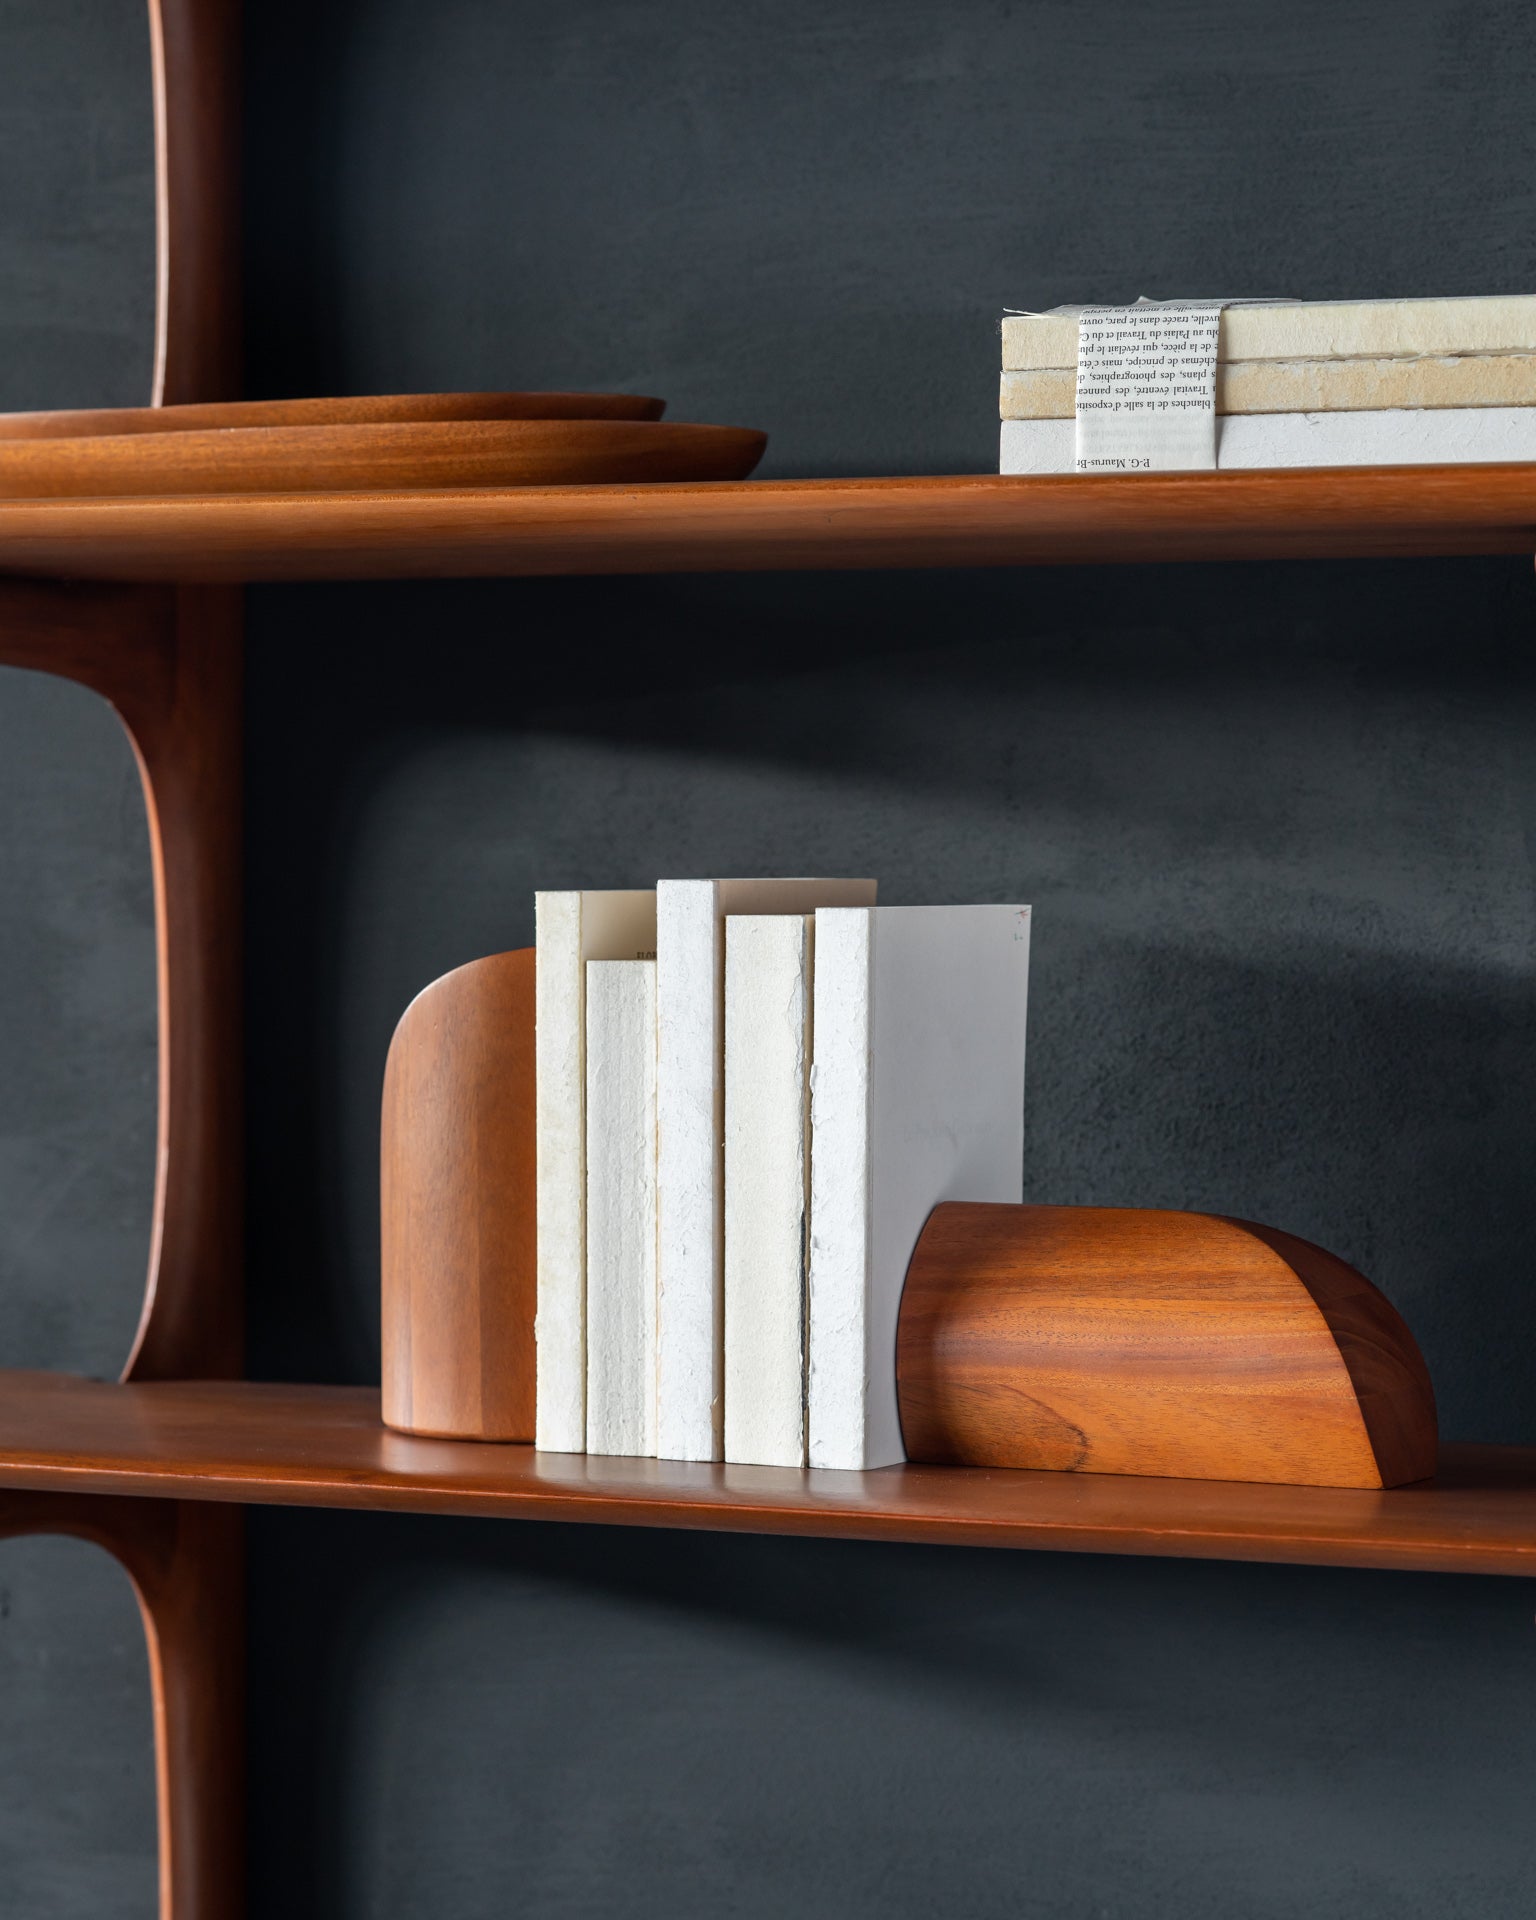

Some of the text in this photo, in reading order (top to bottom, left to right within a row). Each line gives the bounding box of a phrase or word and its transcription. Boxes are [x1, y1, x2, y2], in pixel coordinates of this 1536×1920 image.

[1105, 315, 1128, 324] parc,
[1129, 318, 1137, 327] le
[1139, 317, 1160, 326] dans
[1162, 316, 1189, 325] tracée
[1092, 332, 1104, 341] du
[1116, 331, 1147, 341] Travail
[1149, 331, 1162, 340] du
[1163, 330, 1190, 339] Palais
[1080, 343, 1095, 355] plu
[1097, 346, 1105, 355] le
[1108, 345, 1140, 354] révélait
[1143, 342, 1158, 353] qui
[1161, 341, 1187, 353] pièce,
[1190, 344, 1198, 353] la
[1200, 343, 1212, 353] de
[1101, 360, 1123, 368] mais
[1125, 355, 1165, 368] principe,
[1167, 358, 1179, 367] de
[1089, 371, 1156, 382] photographies,
[1160, 372, 1176, 381] des
[1179, 369, 1207, 380] plans,
[1078, 385, 1111, 395] pannea
[1115, 387, 1130, 397] des
[1134, 386, 1170, 396] éventré,
[1173, 386, 1208, 395] Travital
[1124, 401, 1144, 411] salle
[1147, 401, 1155, 411] la
[1157, 401, 1169, 410] de
[1171, 400, 1211, 410] blanches
